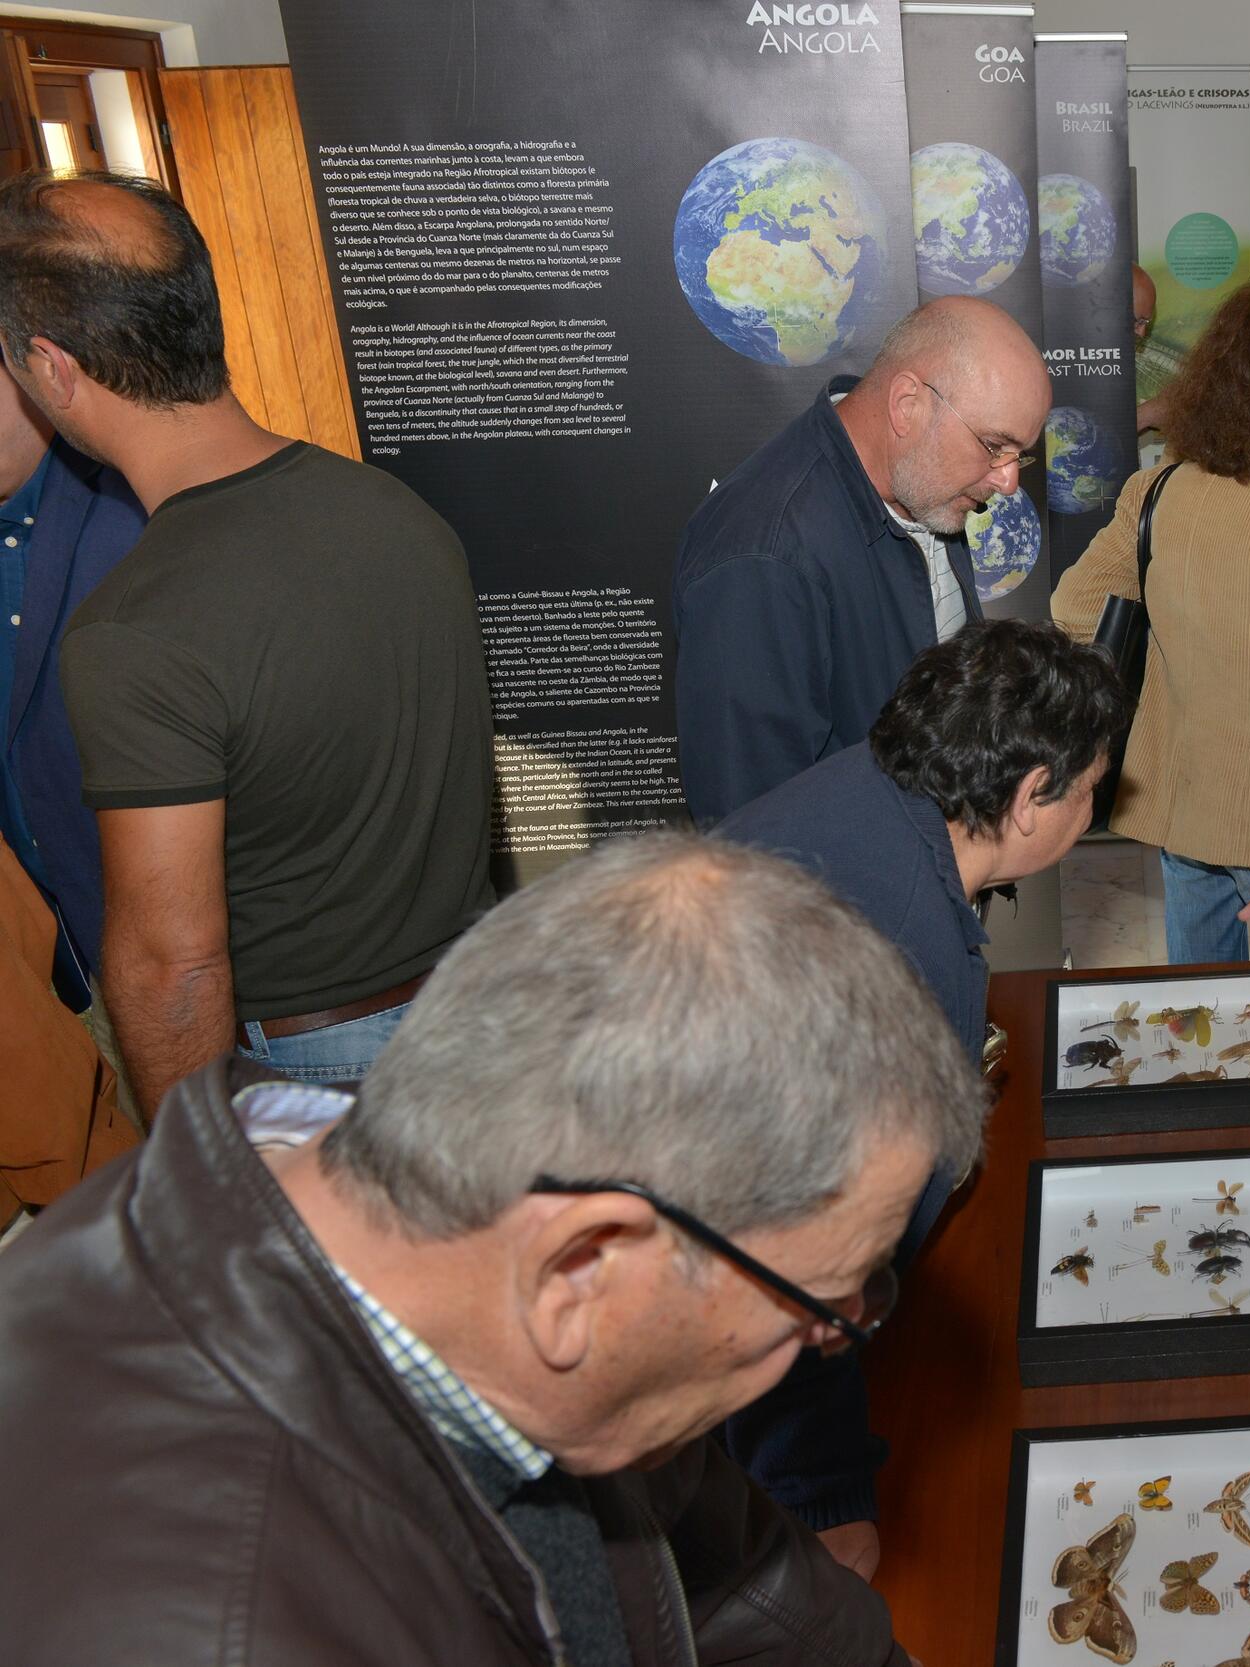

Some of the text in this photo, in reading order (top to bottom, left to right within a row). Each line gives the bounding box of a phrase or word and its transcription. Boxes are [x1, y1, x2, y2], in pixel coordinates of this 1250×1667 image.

[746, 0, 879, 26] ANGOLA
[975, 44, 1025, 64] GOA
[1189, 89, 1195, 97] E
[1197, 89, 1250, 98] CRISOPAS
[1056, 101, 1113, 116] BRASIL
[1137, 100, 1194, 109] LACEWINGS
[1062, 118, 1113, 133] BRAZIL
[319, 145, 346, 155] Angola
[348, 144, 353, 153] é
[370, 144, 401, 152] Mundo!
[403, 143, 409, 151] A
[426, 142, 467, 151] dimensão,
[474, 141, 512, 151] orografia,
[519, 140, 563, 150] hidrografia
[320, 158, 359, 166] influência
[359, 157, 374, 166] das
[413, 156, 450, 164] marinhas
[451, 156, 472, 165] junto
[474, 155, 479, 163] à
[504, 154, 528, 162] levam
[553, 153, 584, 161] embora
[325, 185, 400, 193] consequentemente
[401, 182, 425, 191] fauna
[426, 181, 466, 190] associada)
[467, 181, 481, 189] tão
[481, 181, 515, 189] distintos
[546, 179, 575, 187] floresta
[577, 179, 609, 188] primária
[327, 197, 359, 206] (floresta
[360, 196, 390, 206] tropical
[391, 196, 402, 204] de
[403, 196, 427, 204] chuva
[435, 194, 477, 203] verdadeira
[478, 194, 499, 202] selva,
[508, 193, 539, 202] biótopo
[412, 285, 418, 293] é
[419, 284, 475, 293] acompanhado
[476, 283, 497, 293] pelas
[552, 281, 602, 290] modificações
[345, 300, 388, 309] ecológicas.
[350, 325, 376, 334] Angola
[390, 323, 415, 332] World!
[416, 322, 450, 332] Although
[458, 321, 464, 330] is
[486, 320, 529, 329] Afrotropical
[530, 319, 557, 329] Region,
[352, 337, 391, 346] orography,
[392, 336, 439, 345] hidrography,
[439, 334, 455, 342] and
[469, 333, 502, 341] influence
[502, 332, 511, 340] of
[1080, 347, 1121, 360] LESTE
[359, 374, 386, 383] biotope
[438, 371, 473, 380] biological
[474, 370, 494, 378] level),
[523, 368, 537, 376] and
[1074, 364, 1121, 376] TIMOR
